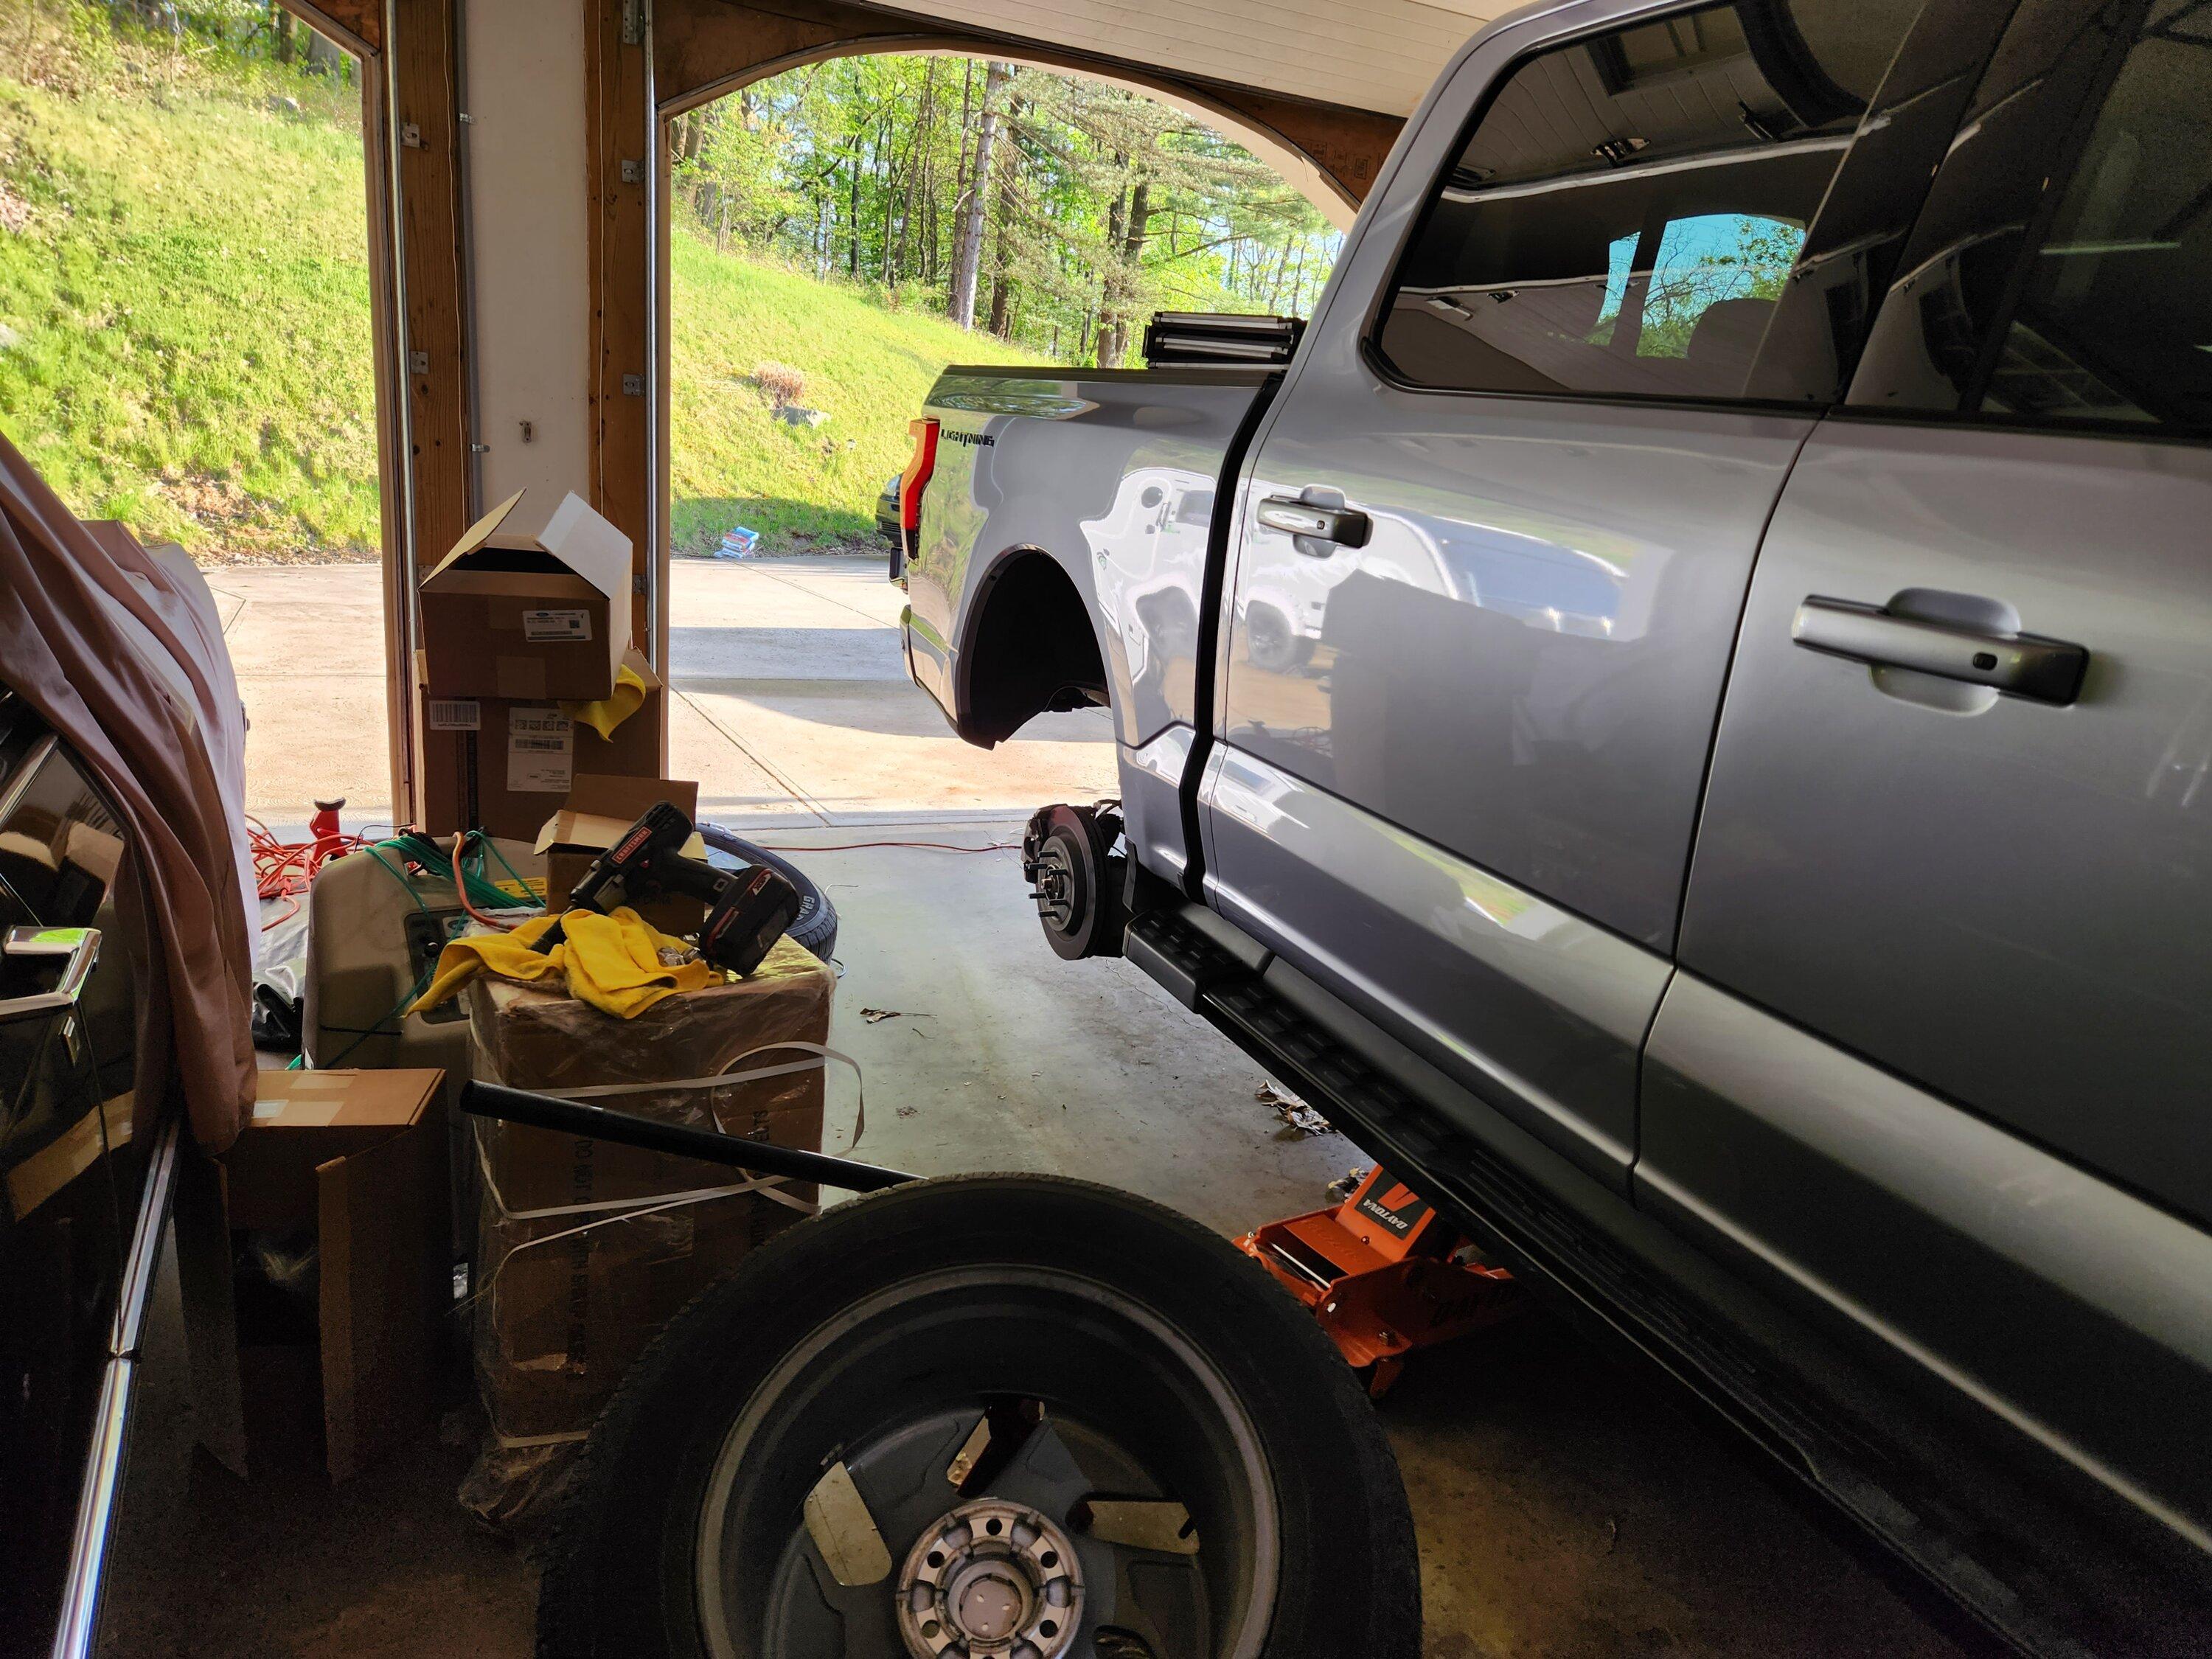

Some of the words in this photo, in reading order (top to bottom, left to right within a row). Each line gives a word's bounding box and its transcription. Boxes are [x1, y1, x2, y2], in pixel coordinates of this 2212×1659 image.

[941, 428, 995, 447] LIGHTNING
[616, 830, 648, 860] CRAFTSMAN
[1363, 1198, 1408, 1230] DAYTONA
